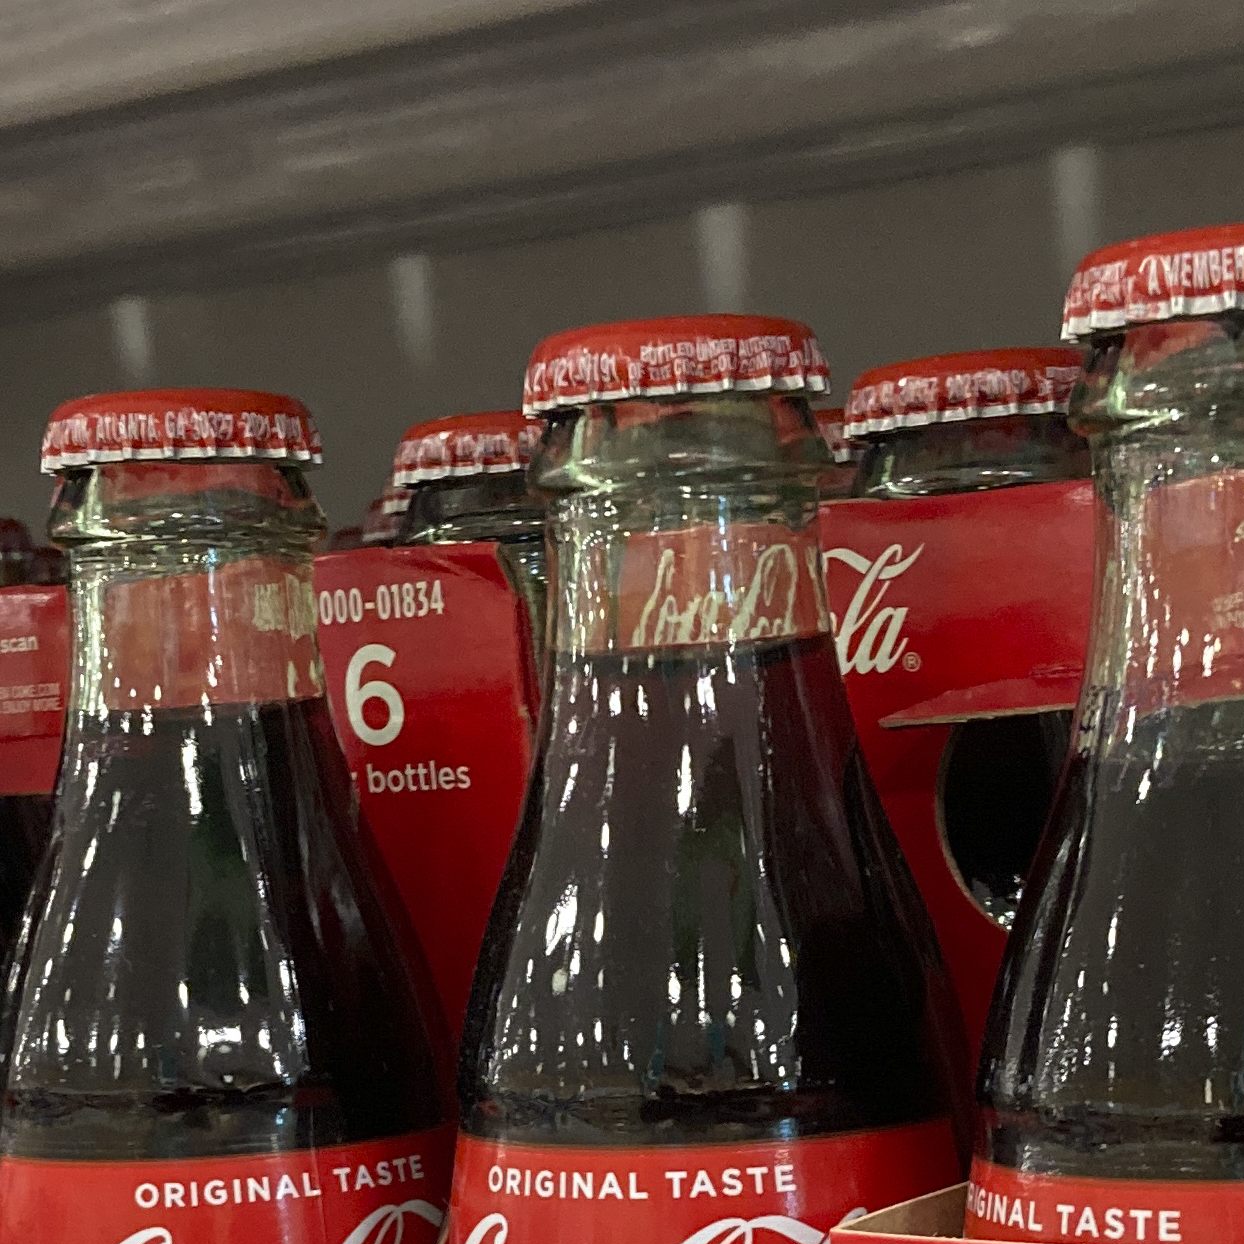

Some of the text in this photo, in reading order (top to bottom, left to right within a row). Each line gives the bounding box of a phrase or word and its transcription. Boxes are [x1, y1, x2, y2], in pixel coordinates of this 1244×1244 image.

[319, 579, 445, 625] 000-01834
[345, 643, 405, 746] 6
[366, 760, 472, 794] bottles
[135, 1155, 426, 1209] ORIGINAL TASTE
[488, 1164, 798, 1200] ORIGINAL TASTE
[1056, 1203, 1182, 1242] TASTE
